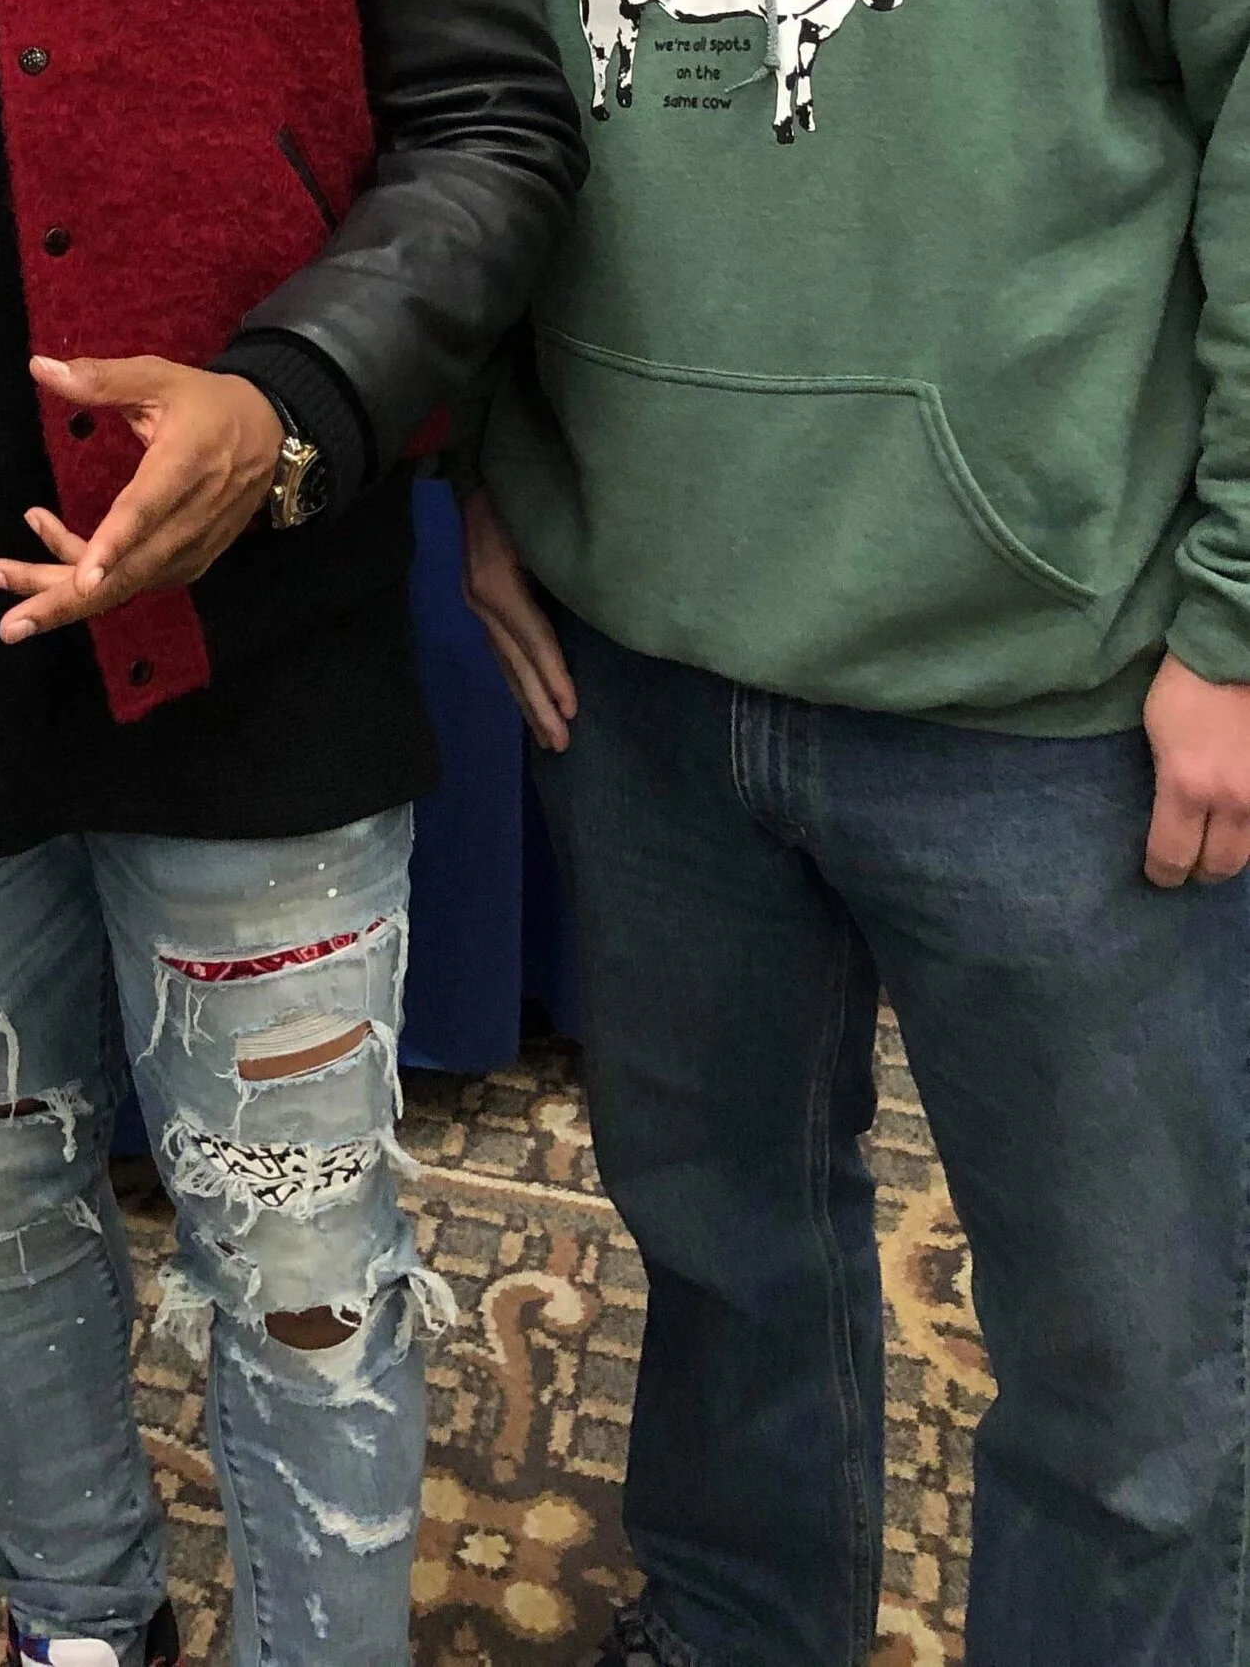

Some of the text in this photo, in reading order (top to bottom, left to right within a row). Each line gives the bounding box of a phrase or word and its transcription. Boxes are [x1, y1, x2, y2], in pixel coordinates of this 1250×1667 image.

[654, 36, 751, 55] we're all spots
[676, 65, 721, 80] on the
[663, 95, 731, 110] same cow
